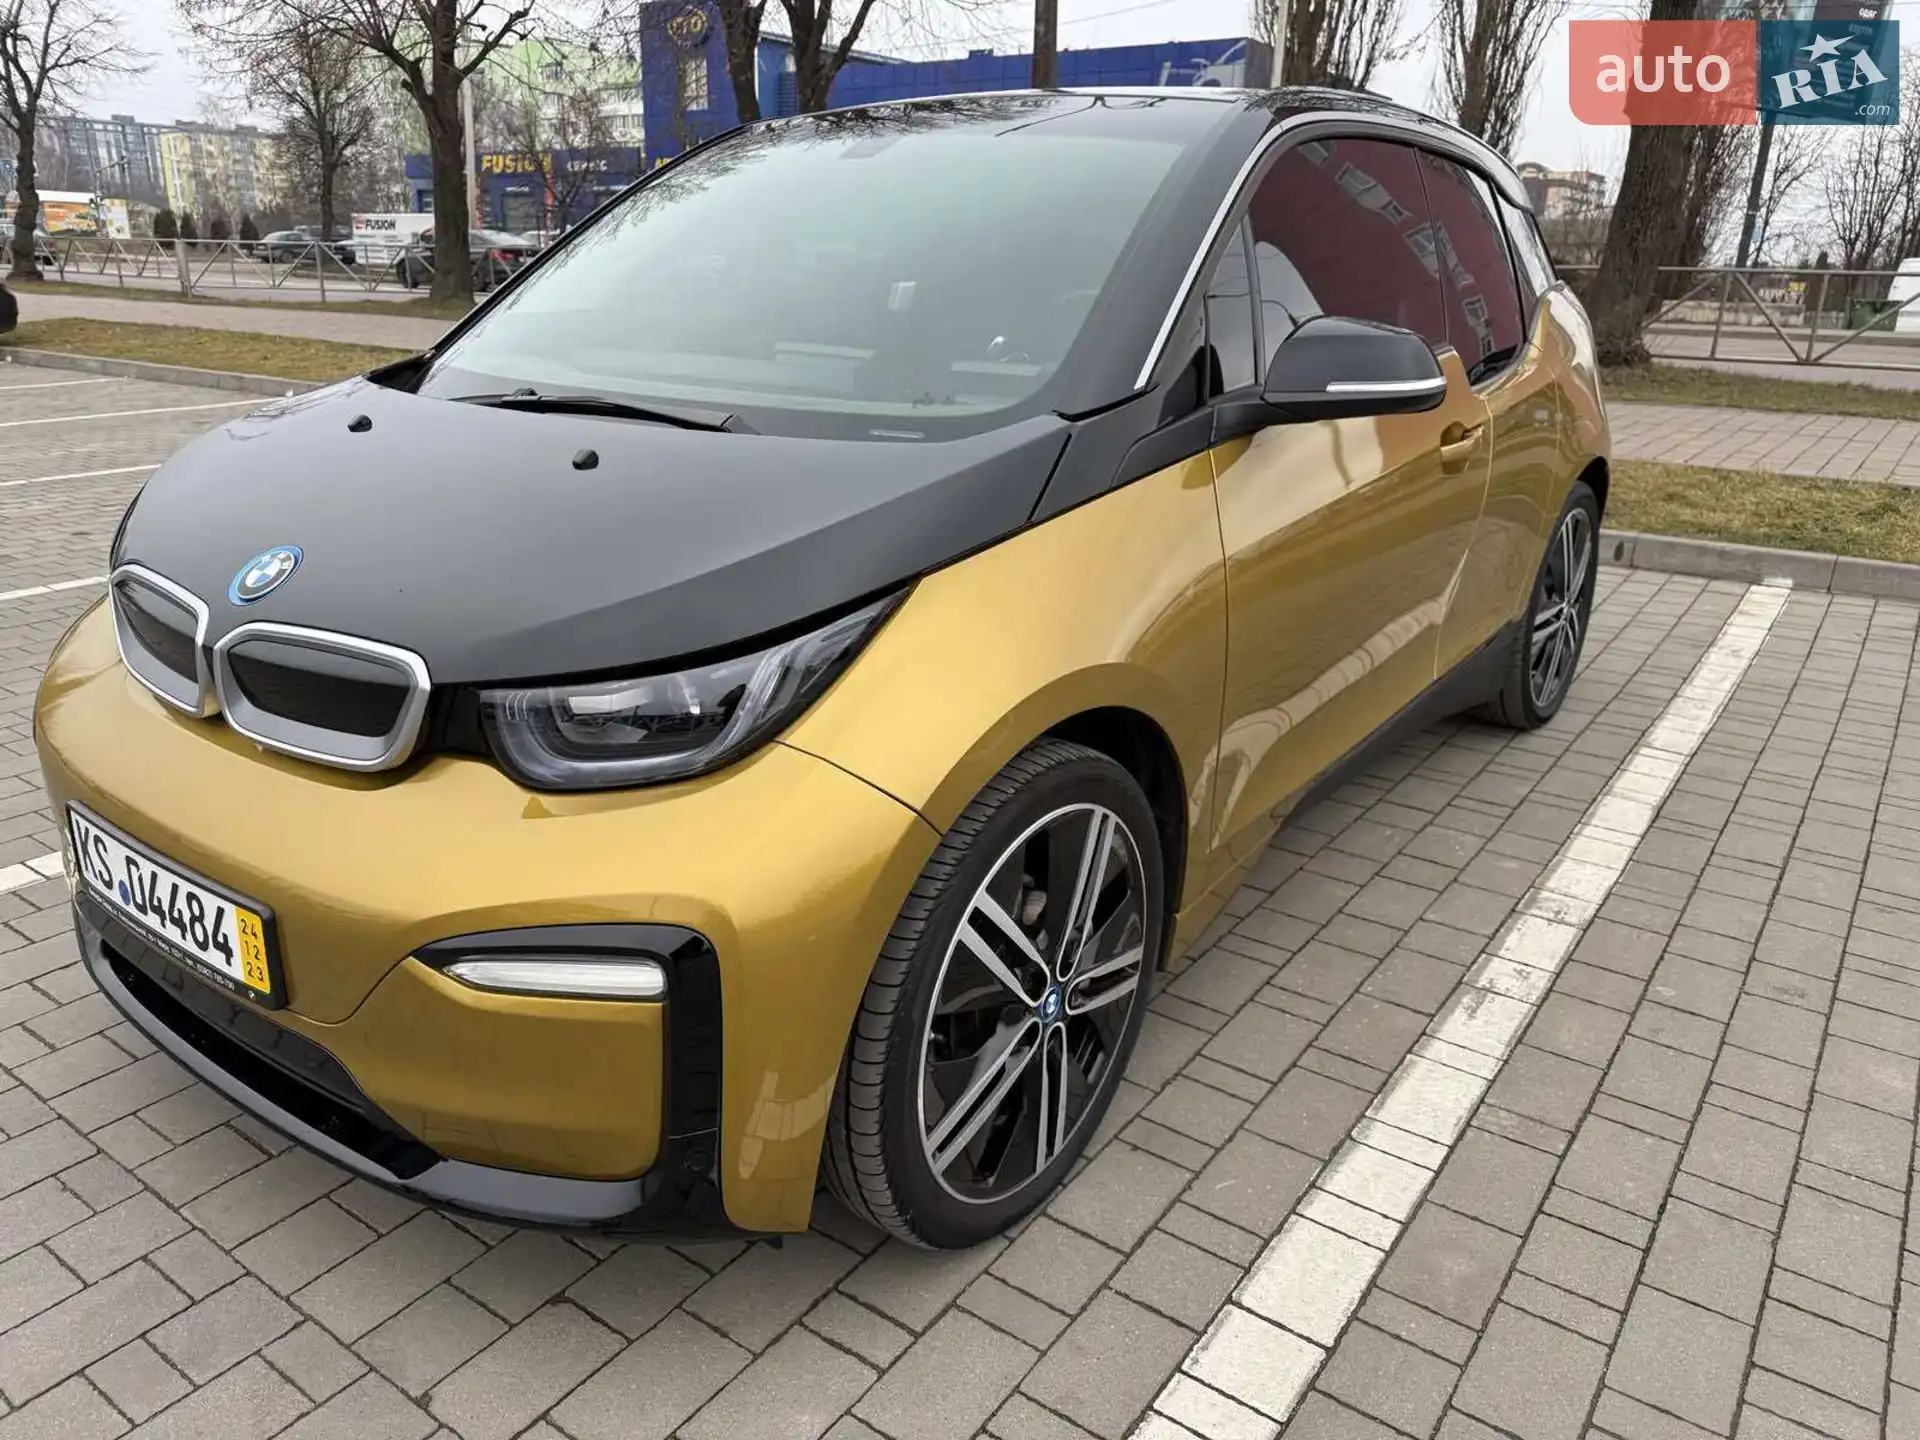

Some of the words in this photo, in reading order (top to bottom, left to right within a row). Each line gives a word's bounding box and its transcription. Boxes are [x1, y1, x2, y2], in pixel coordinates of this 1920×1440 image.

[365, 219, 396, 231] FUSION
[76, 819, 114, 891] KS
[125, 855, 234, 967] 04484
[240, 918, 258, 940] 24
[244, 940, 261, 961] 12
[246, 961, 264, 983] 23
